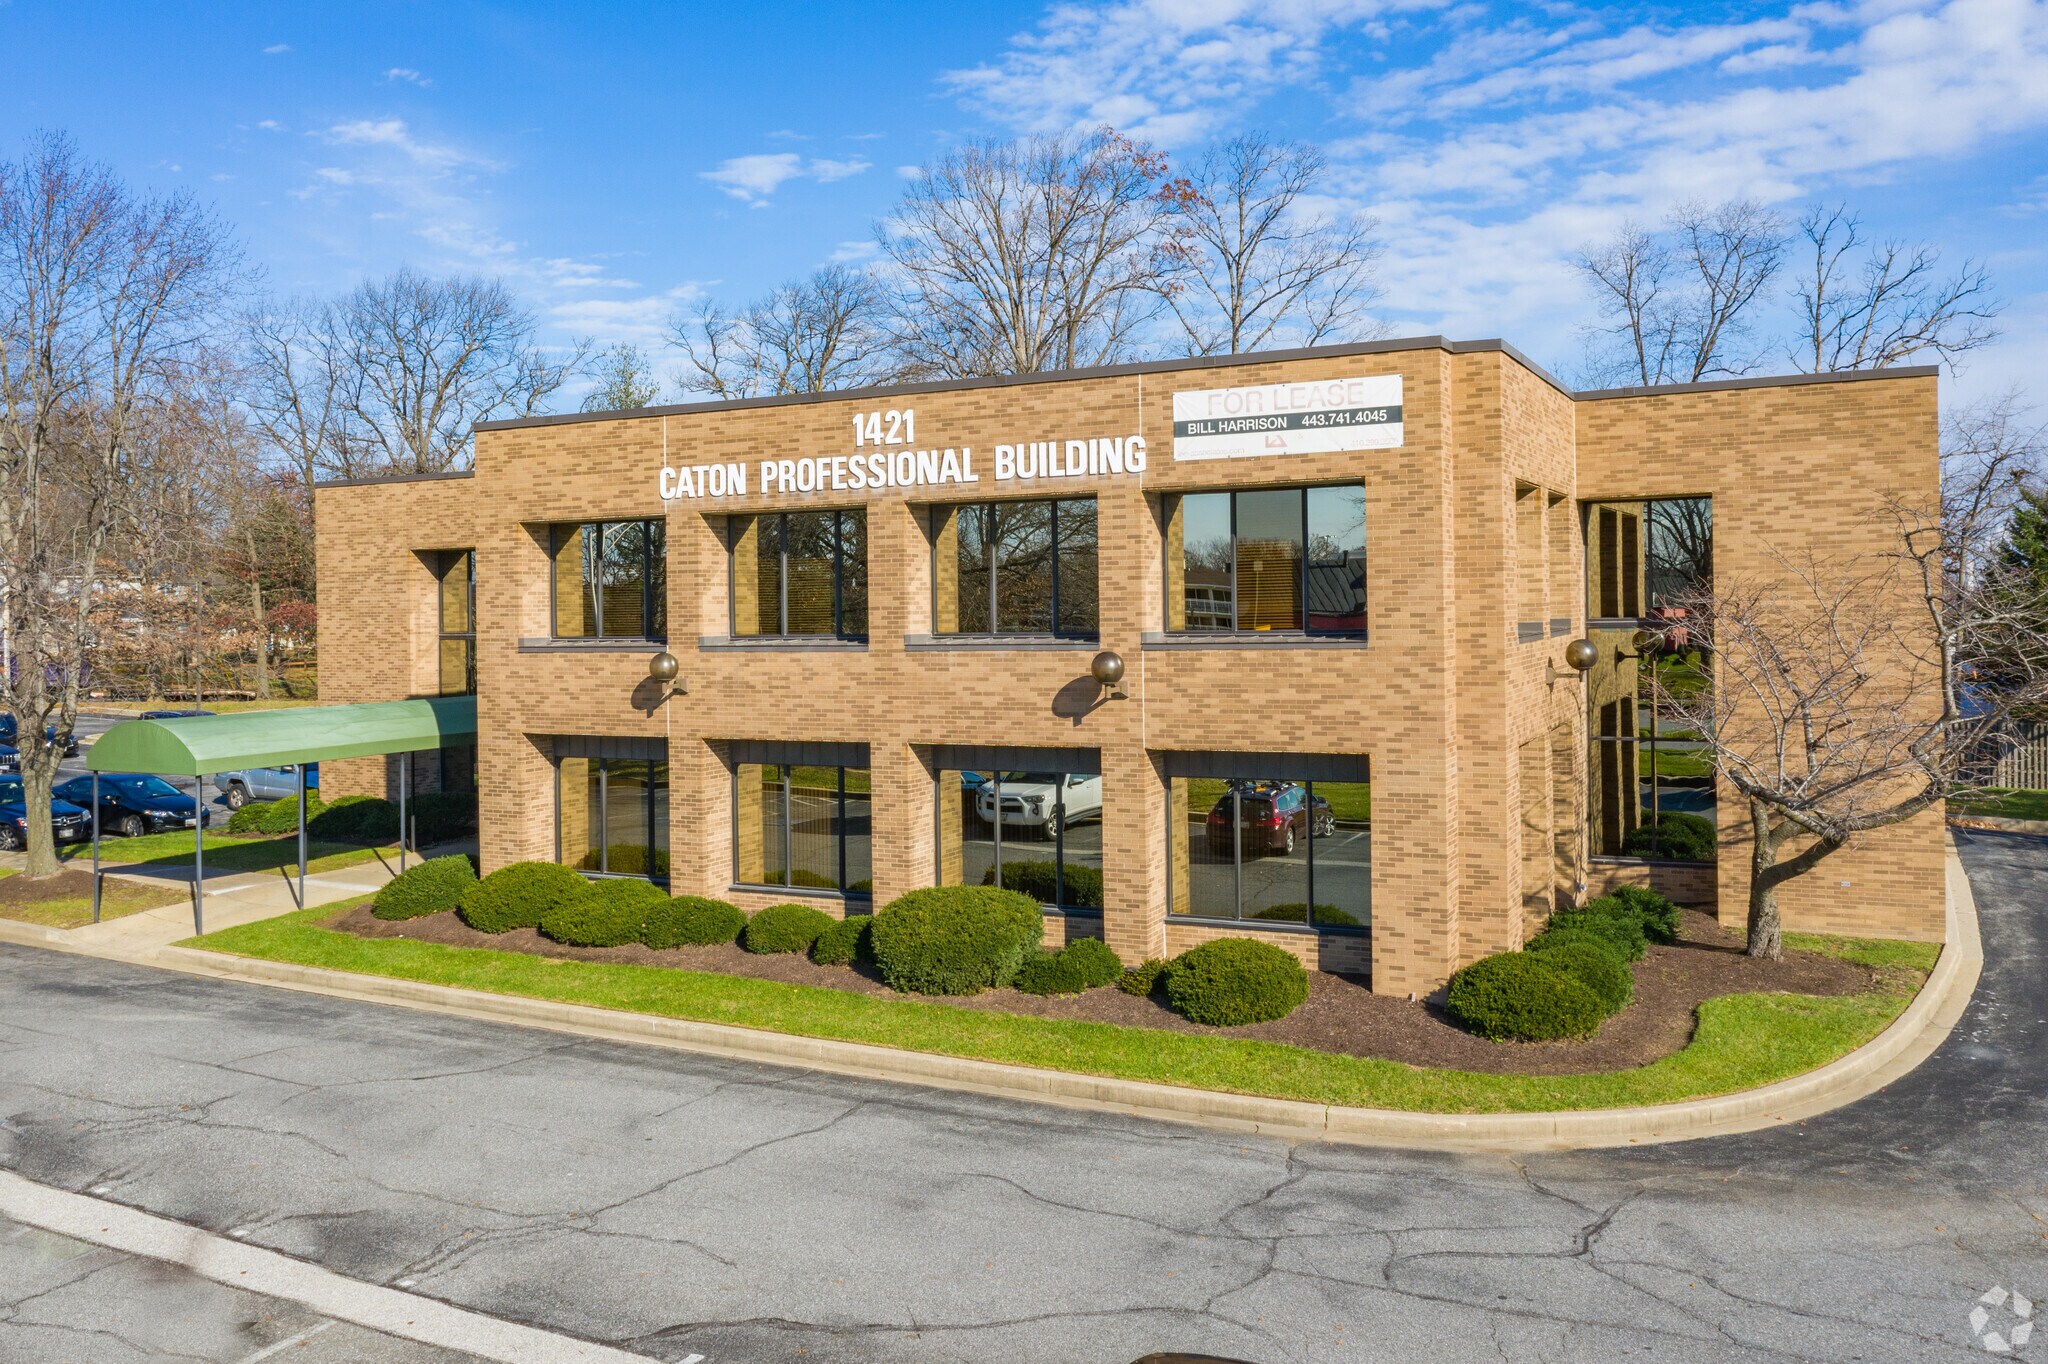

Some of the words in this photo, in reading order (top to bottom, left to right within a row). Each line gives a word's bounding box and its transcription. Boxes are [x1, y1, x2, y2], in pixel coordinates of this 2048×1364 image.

[1207, 390, 1263, 415] FOR
[1273, 382, 1364, 411] LEASE
[852, 409, 914, 447] 1421
[1187, 421, 1216, 435] BILL
[1218, 417, 1288, 432] HARRISON
[1301, 410, 1387, 427] 443.741.4045
[659, 463, 746, 499] CATON
[760, 448, 979, 494] PROFESSIONAL
[994, 436, 1147, 481] BUILDING
